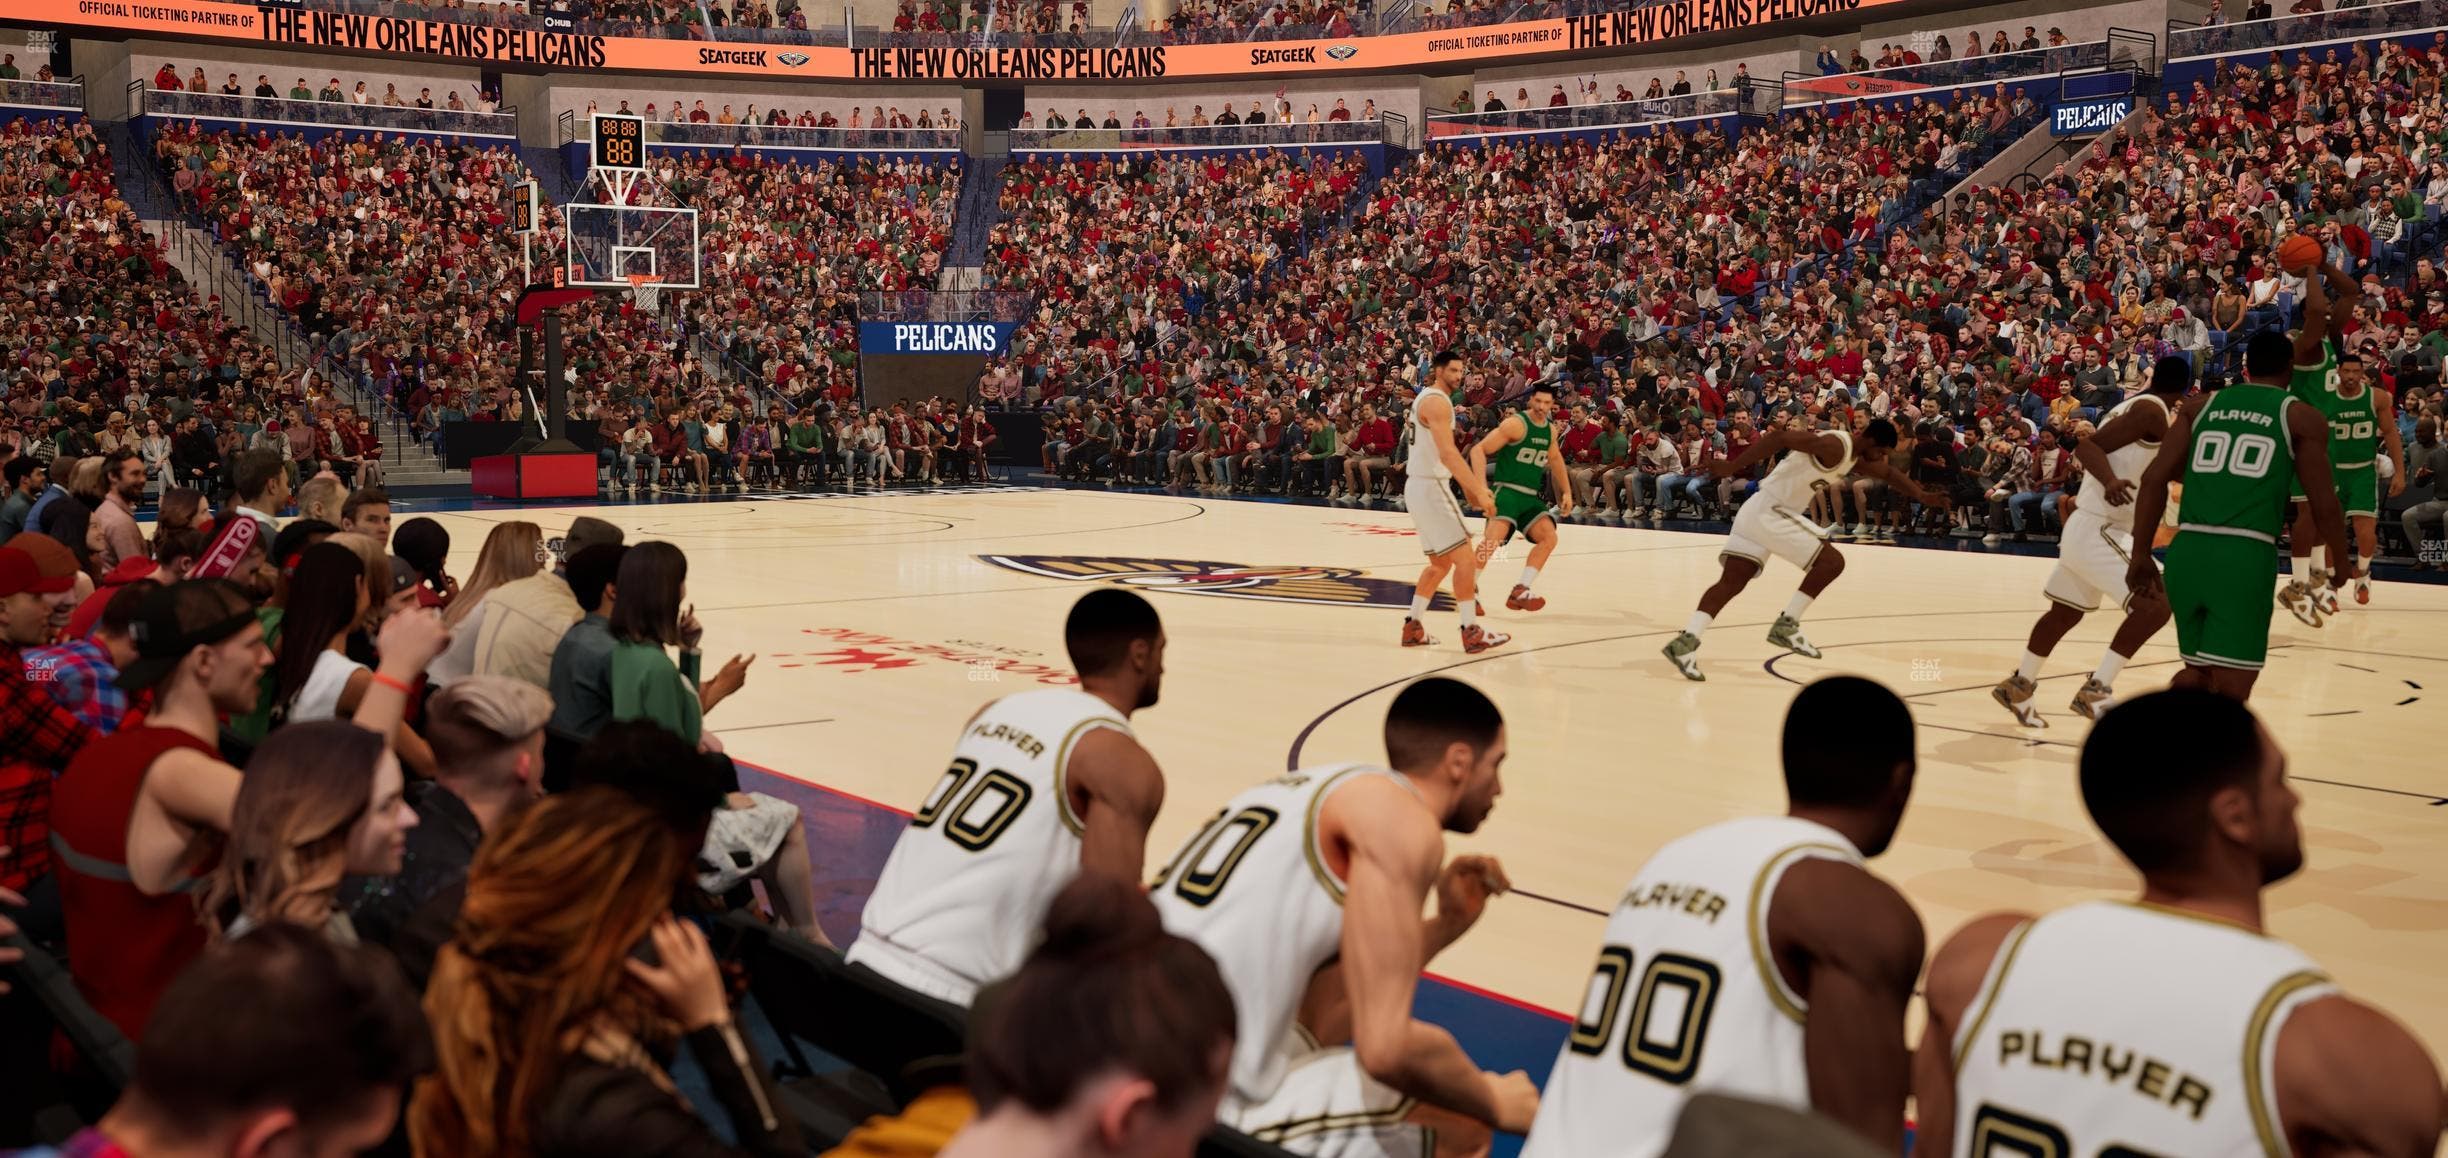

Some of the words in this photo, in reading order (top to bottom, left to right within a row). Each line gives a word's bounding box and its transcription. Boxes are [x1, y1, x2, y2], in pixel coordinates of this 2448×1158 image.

[79, 1, 130, 18] OFFICIAL
[132, 5, 189, 23] TICKETING
[191, 11, 238, 27] PARTNER
[241, 15, 254, 28] OF
[258, 7, 307, 43] THE
[312, 11, 369, 48] NEW
[375, 17, 489, 58] ORLEANS
[493, 29, 606, 67] PELICANS
[1428, 36, 1464, 53] OFFICIAL
[1466, 33, 1510, 49] TICKETING
[1512, 29, 1549, 45] PARTNER
[1552, 28, 1563, 41] OF
[1566, 14, 1607, 49] THE
[1612, 8, 1656, 45] NEW
[699, 47, 768, 68] SEATGEEK
[850, 48, 893, 78] THE
[897, 48, 948, 78] NEW
[951, 47, 1056, 78] ORLEANS
[1061, 46, 1166, 78] PELICANS
[1250, 46, 1316, 66] SEATGEEK
[602, 120, 618, 135] 88
[621, 121, 637, 136] 88
[2057, 102, 2126, 130] PELICANS
[607, 138, 633, 165] 88
[895, 324, 996, 351] PELICANS
[2208, 409, 2274, 428] PLAYER
[2191, 430, 2277, 479] 00
[1998, 1029, 2215, 1122] PLAYER
